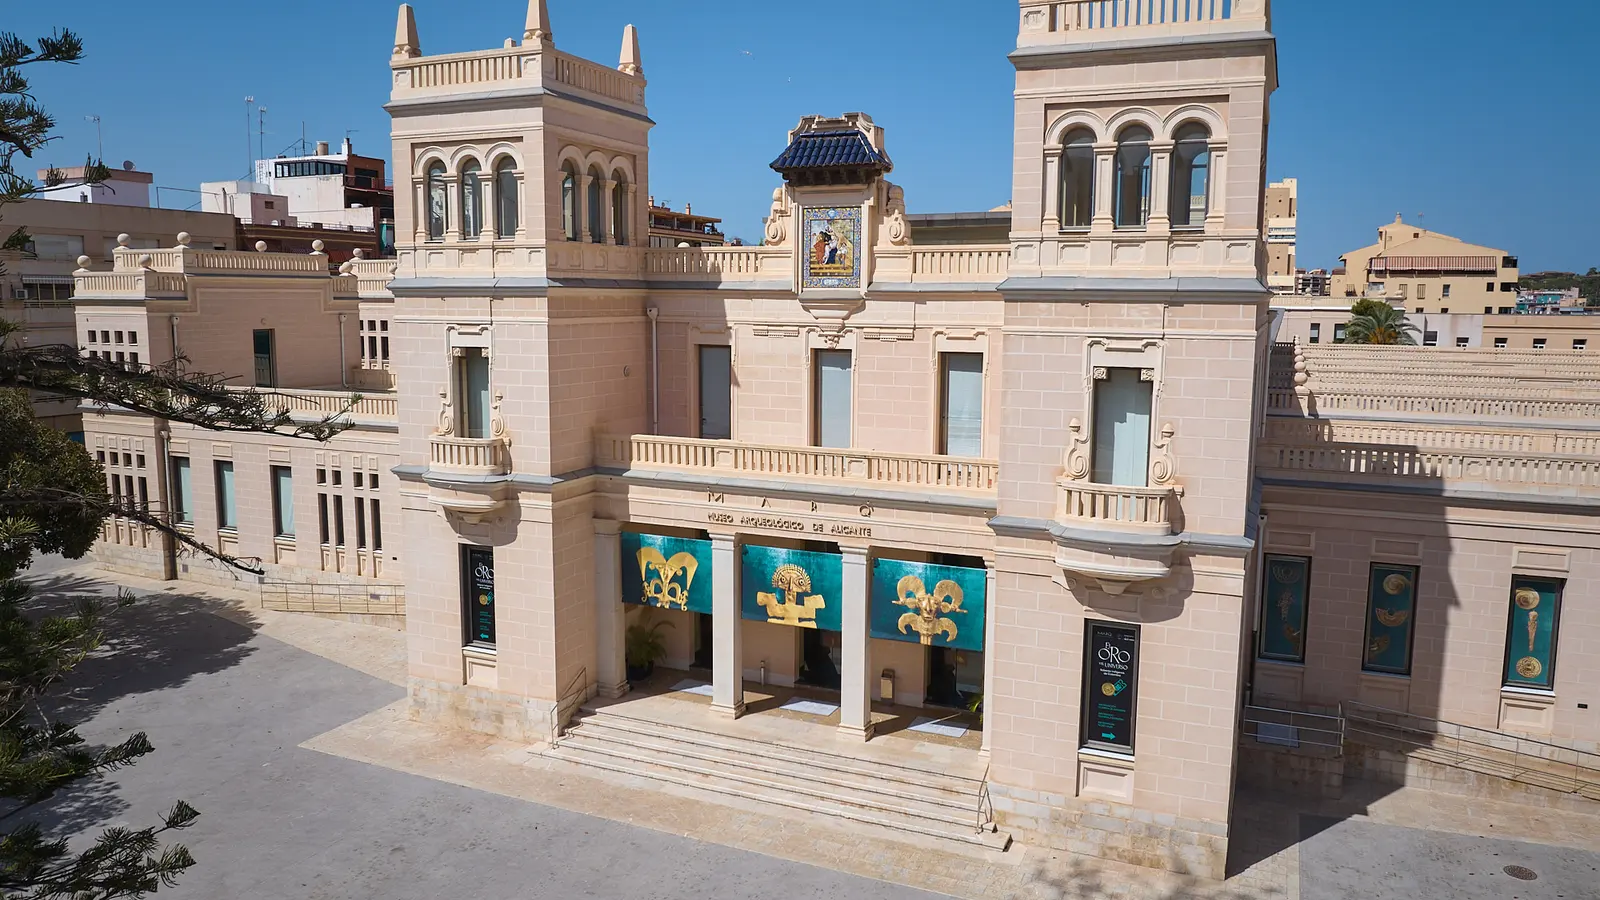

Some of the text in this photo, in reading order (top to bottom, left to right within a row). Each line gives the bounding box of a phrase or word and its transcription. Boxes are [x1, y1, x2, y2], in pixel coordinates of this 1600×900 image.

[708, 491, 875, 517] MARQ
[708, 511, 872, 537] MUSEO ARQUEOLÓGICO DE ALICANTE
[1098, 646, 1130, 664] ORO
